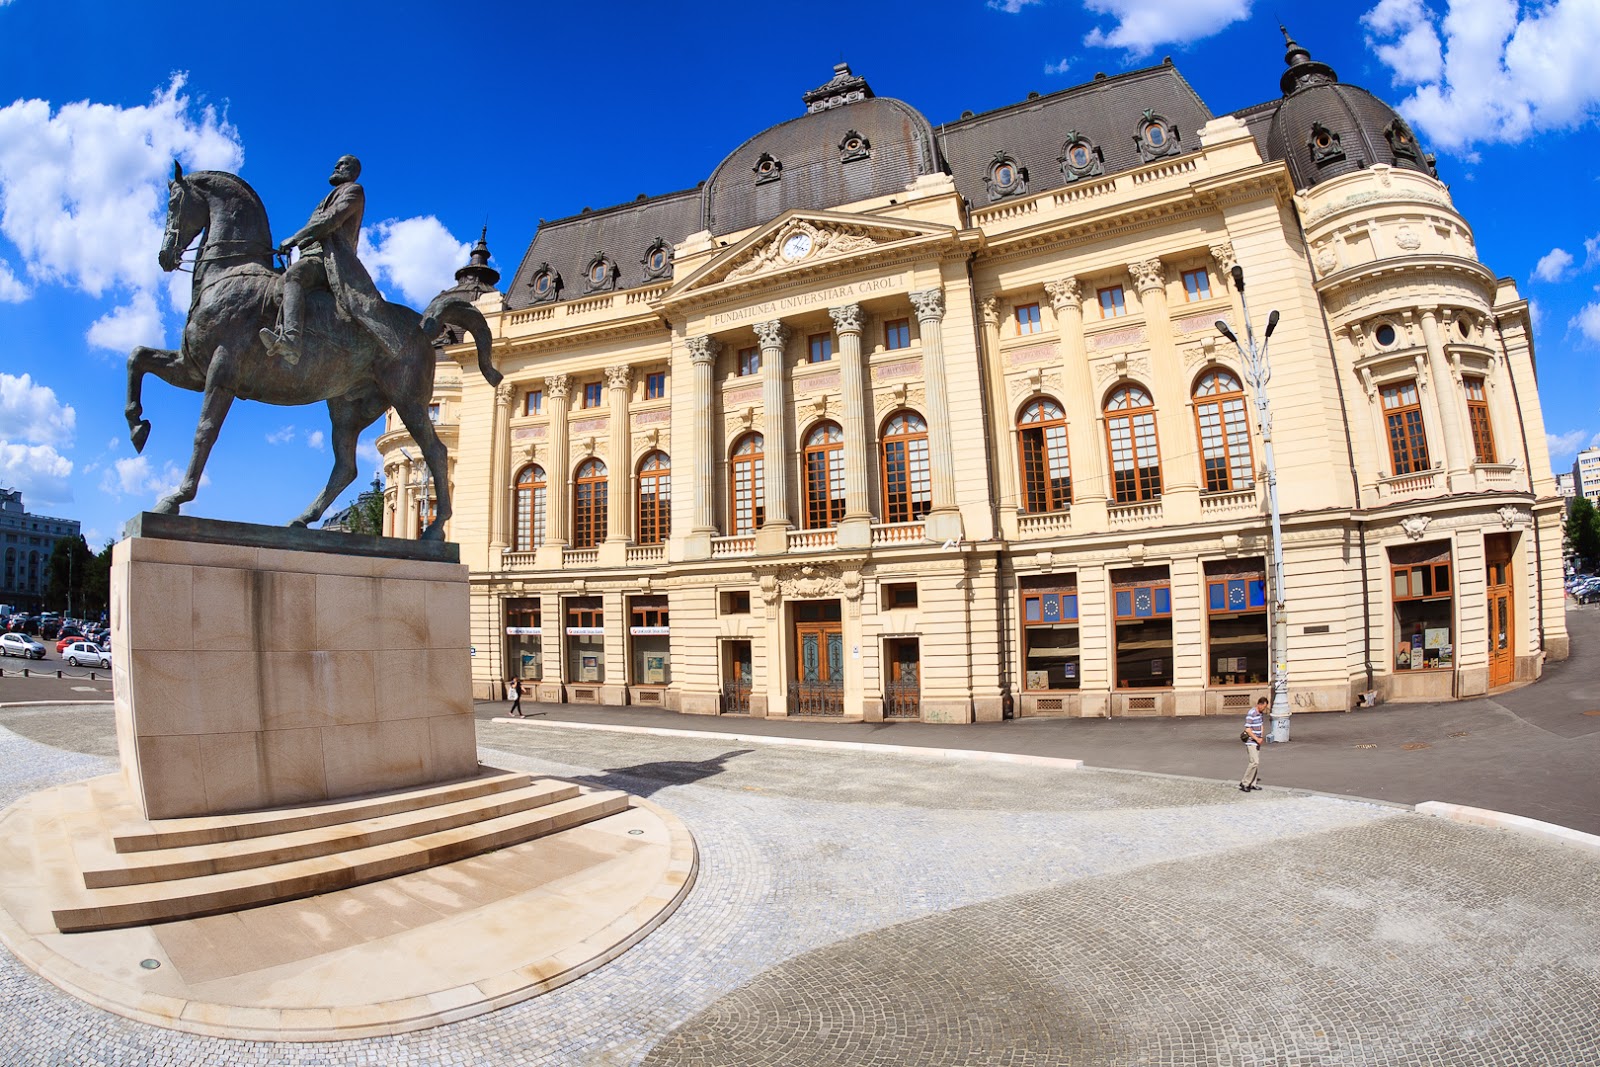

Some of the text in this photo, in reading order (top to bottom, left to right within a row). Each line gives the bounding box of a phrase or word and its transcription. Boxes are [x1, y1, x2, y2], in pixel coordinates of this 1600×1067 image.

[715, 275, 904, 325] FUNDATIUNEA UNIVERSITARA CAROL I
